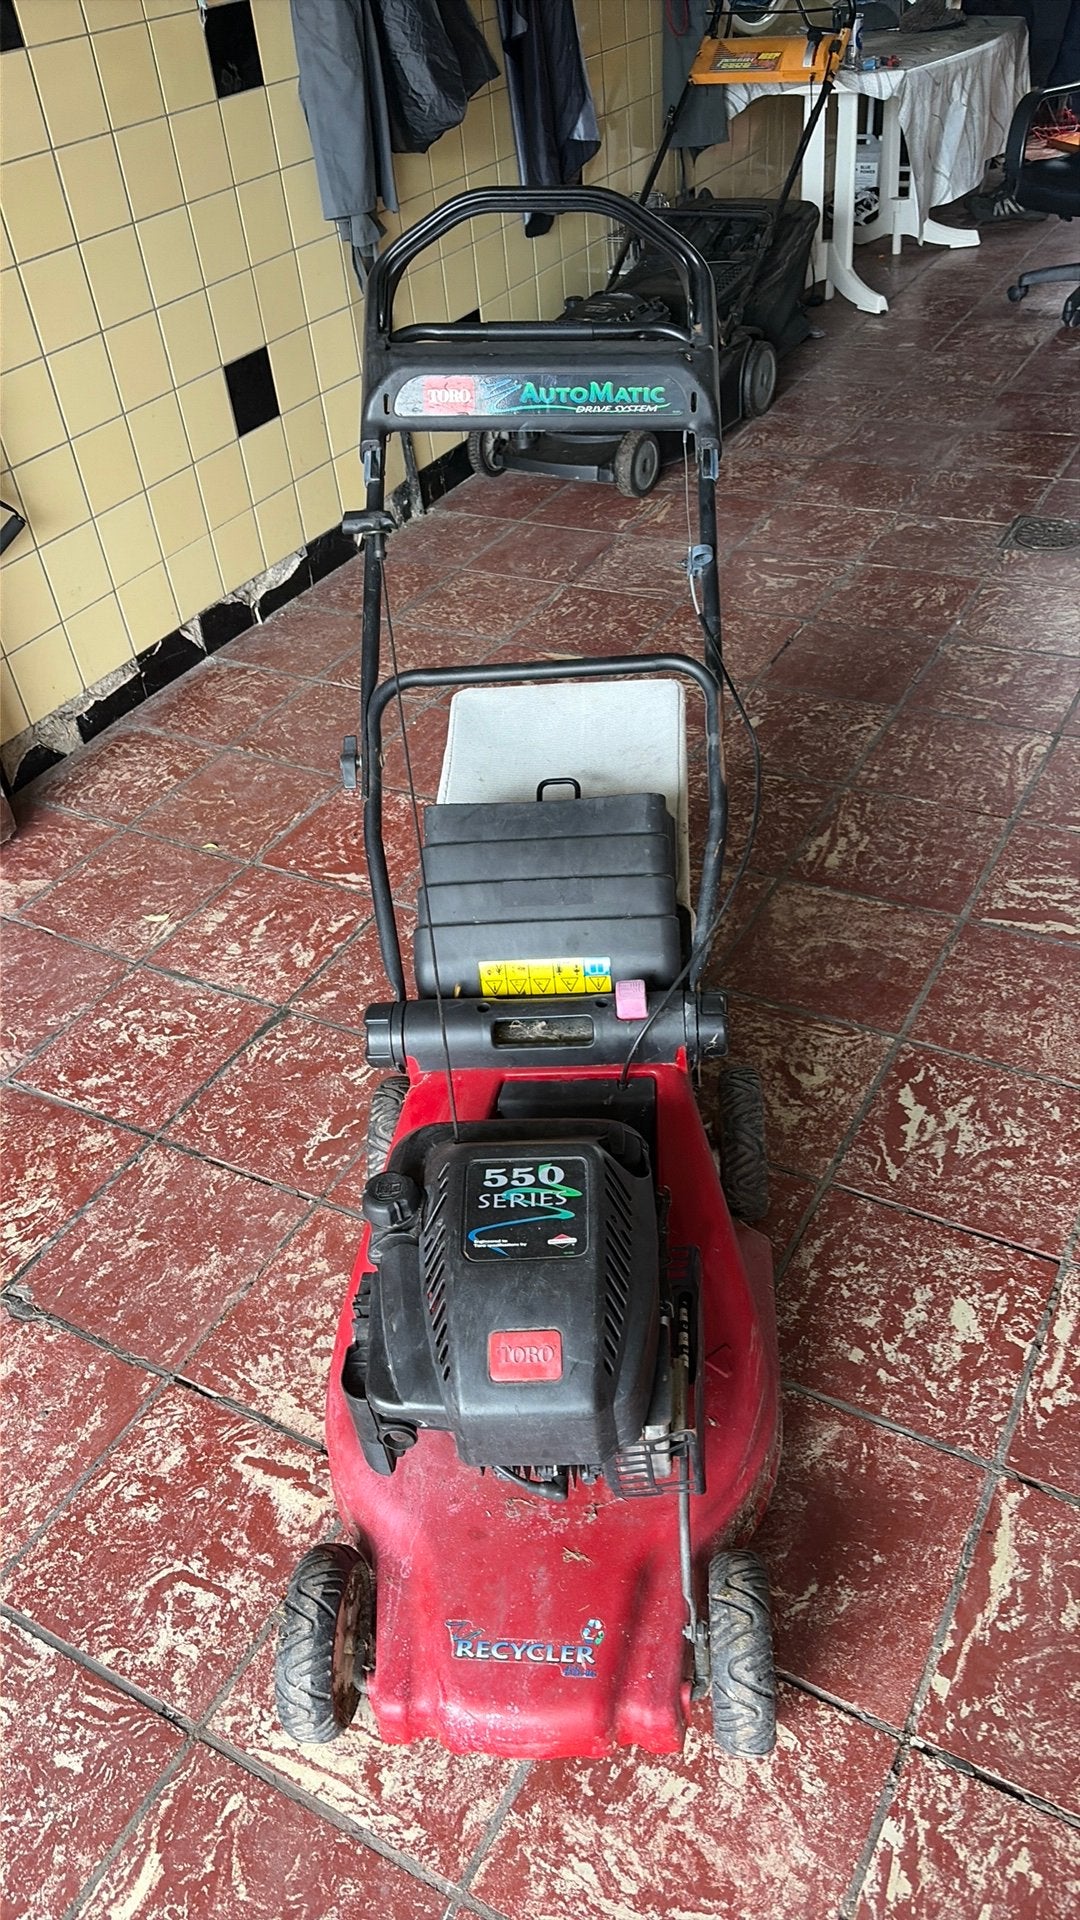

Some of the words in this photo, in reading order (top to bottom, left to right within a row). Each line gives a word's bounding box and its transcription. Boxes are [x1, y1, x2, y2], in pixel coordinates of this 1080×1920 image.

[427, 389, 471, 403] TORO
[575, 405, 612, 413] DRIVE
[613, 404, 658, 413] SYSTEM
[483, 1165, 565, 1188] 550
[478, 1190, 567, 1209] SERIES
[496, 1344, 555, 1364] TORO
[455, 1640, 596, 1665] RECYCLER
